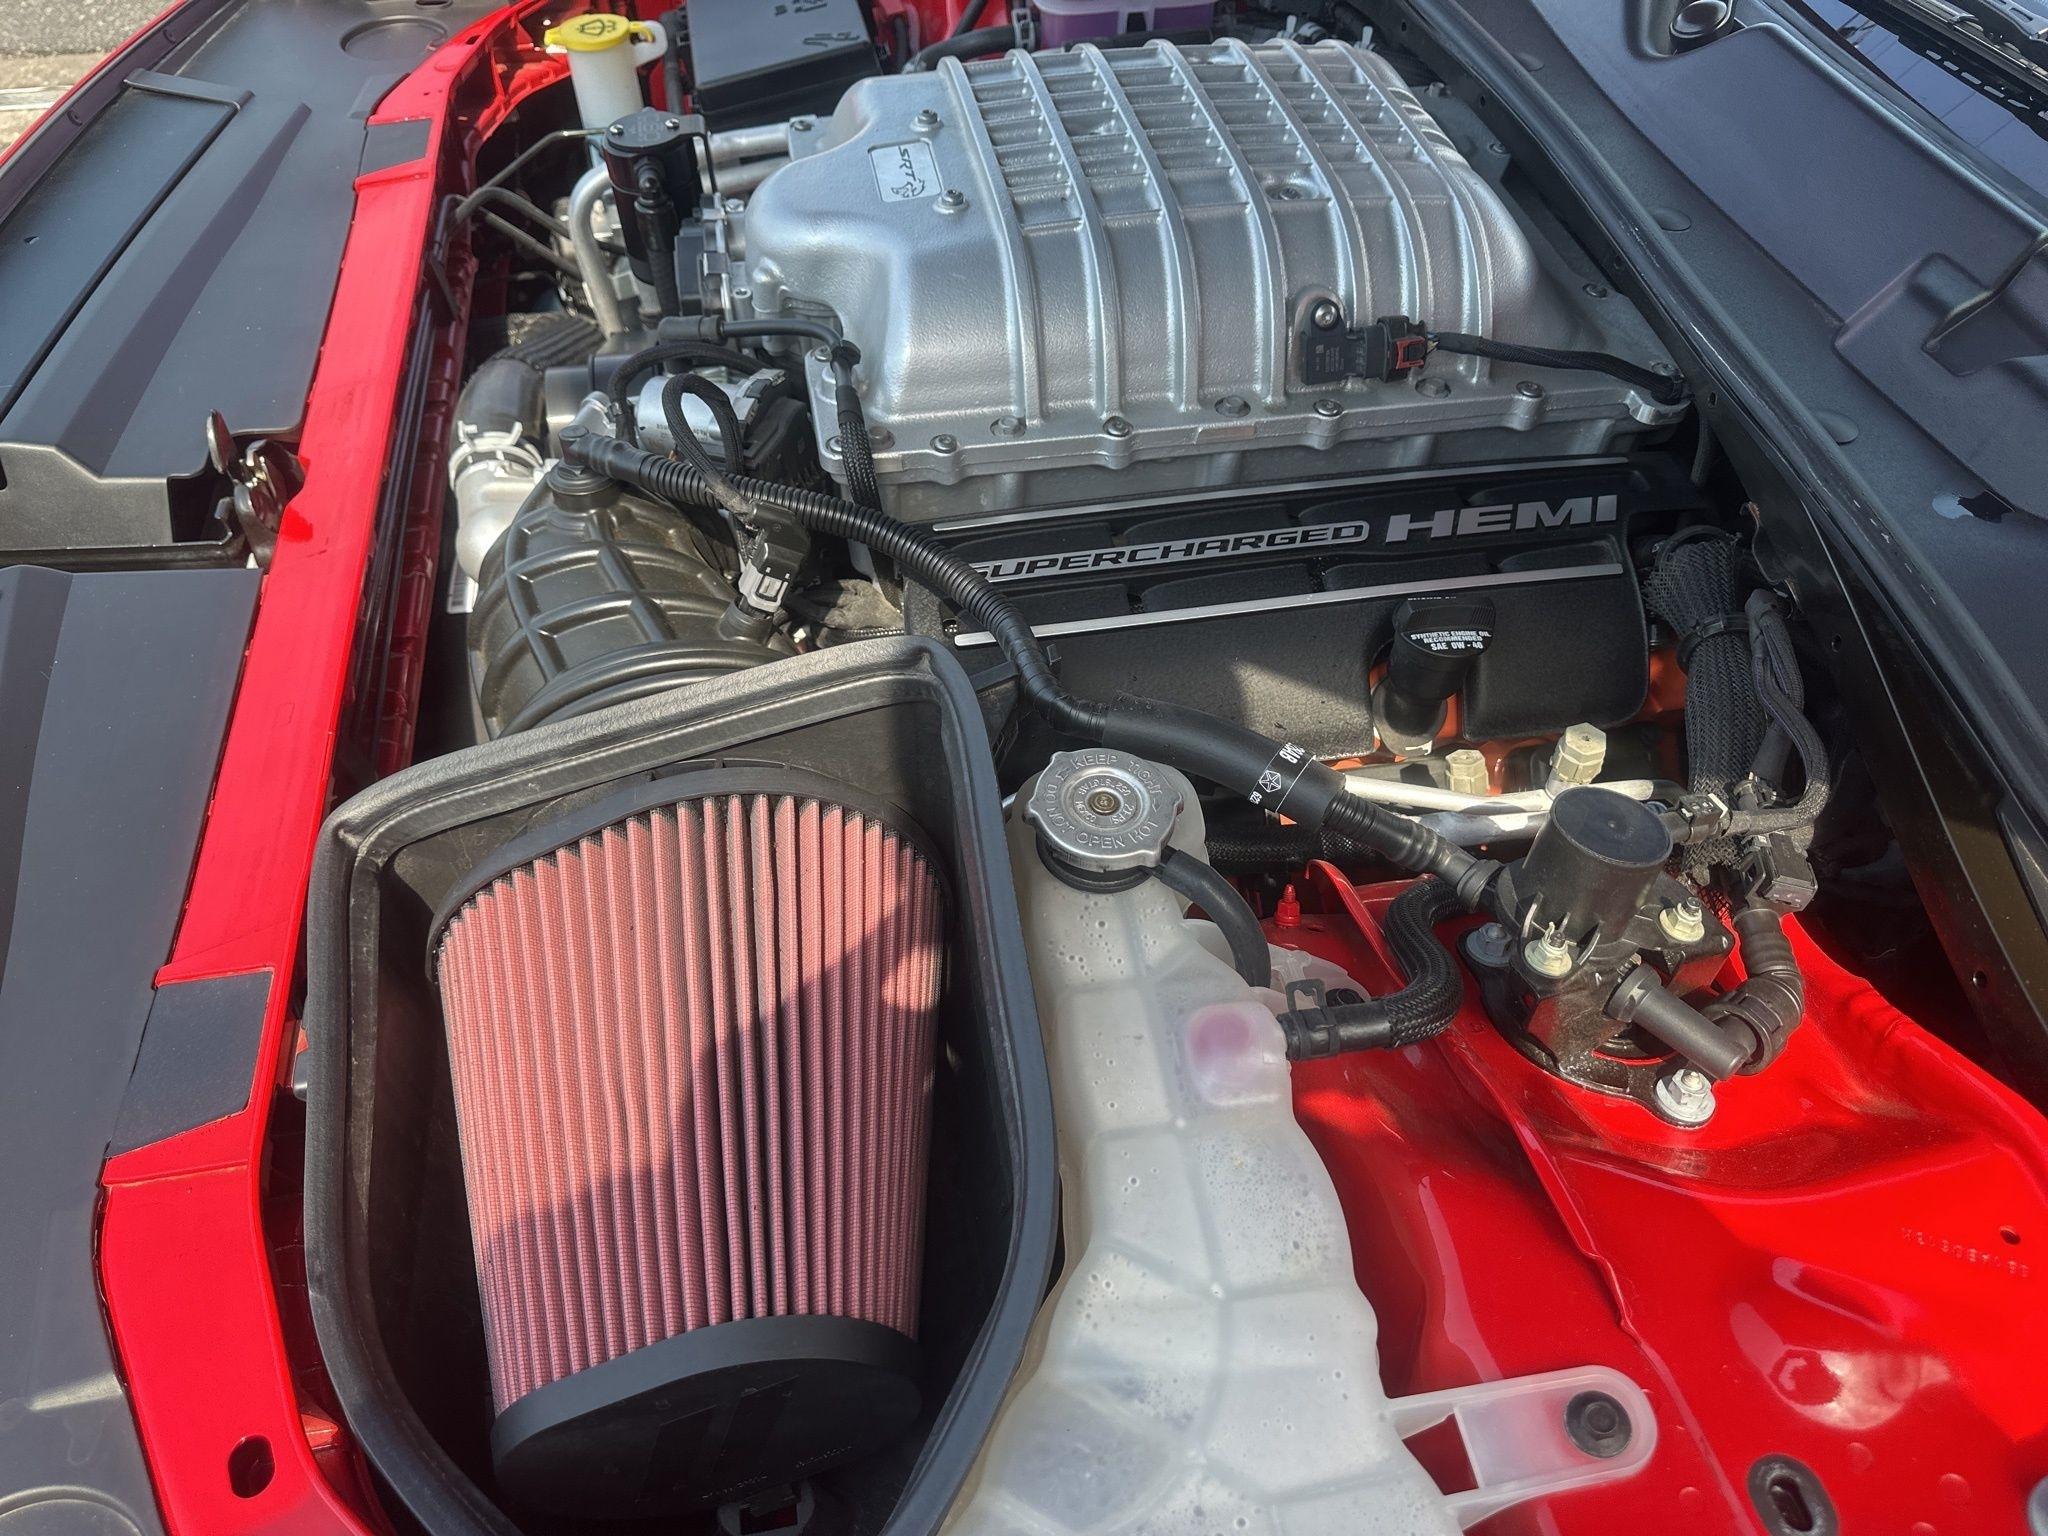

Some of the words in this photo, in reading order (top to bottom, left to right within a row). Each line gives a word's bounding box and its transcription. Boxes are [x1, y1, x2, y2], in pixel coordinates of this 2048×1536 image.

[898, 145, 917, 181] SRT
[1386, 494, 1617, 543] HEMI
[1410, 631, 1451, 640] SYNTHETIC
[1430, 642, 1449, 651] SAE
[1071, 754, 1117, 770] KEEP
[1129, 760, 1163, 795] TIGHT
[1046, 807, 1075, 833] NOT
[1076, 832, 1125, 849] OPEN
[1129, 821, 1159, 844] HOT
